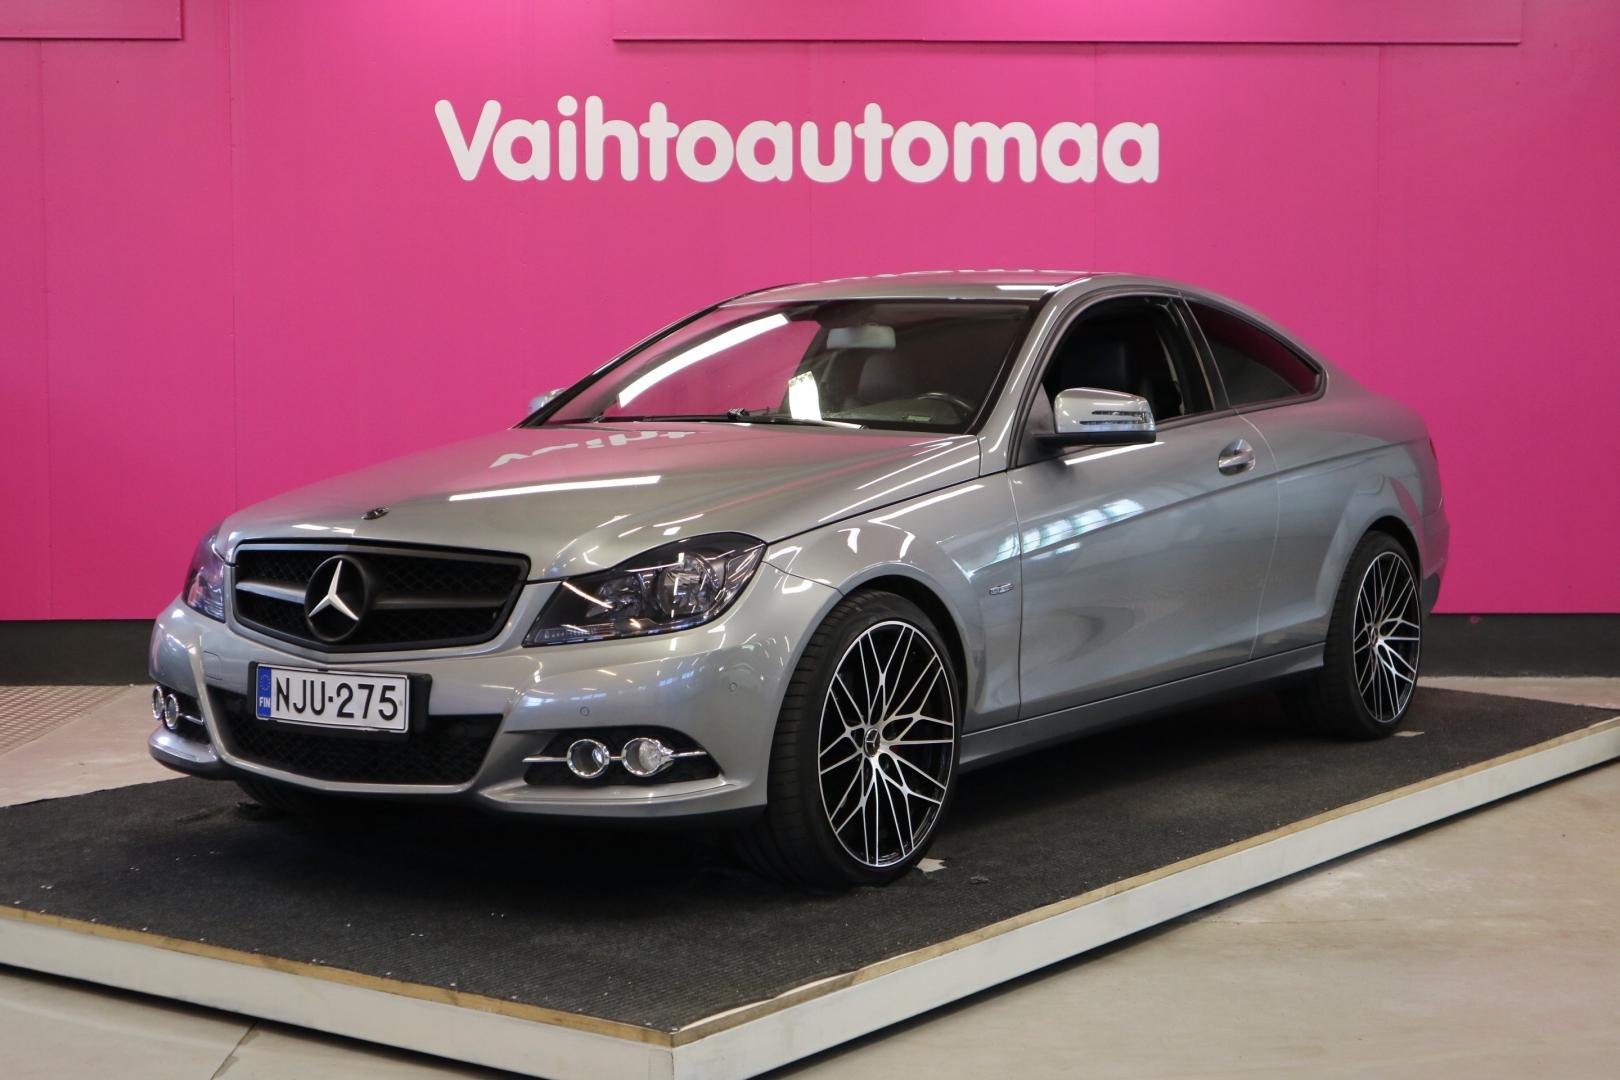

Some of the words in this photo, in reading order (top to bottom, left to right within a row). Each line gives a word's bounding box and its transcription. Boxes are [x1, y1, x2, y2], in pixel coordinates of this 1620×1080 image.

[434, 95, 1160, 183] Vaihtoautomaa
[259, 696, 271, 708] FIN
[276, 677, 398, 721] NJU-275
